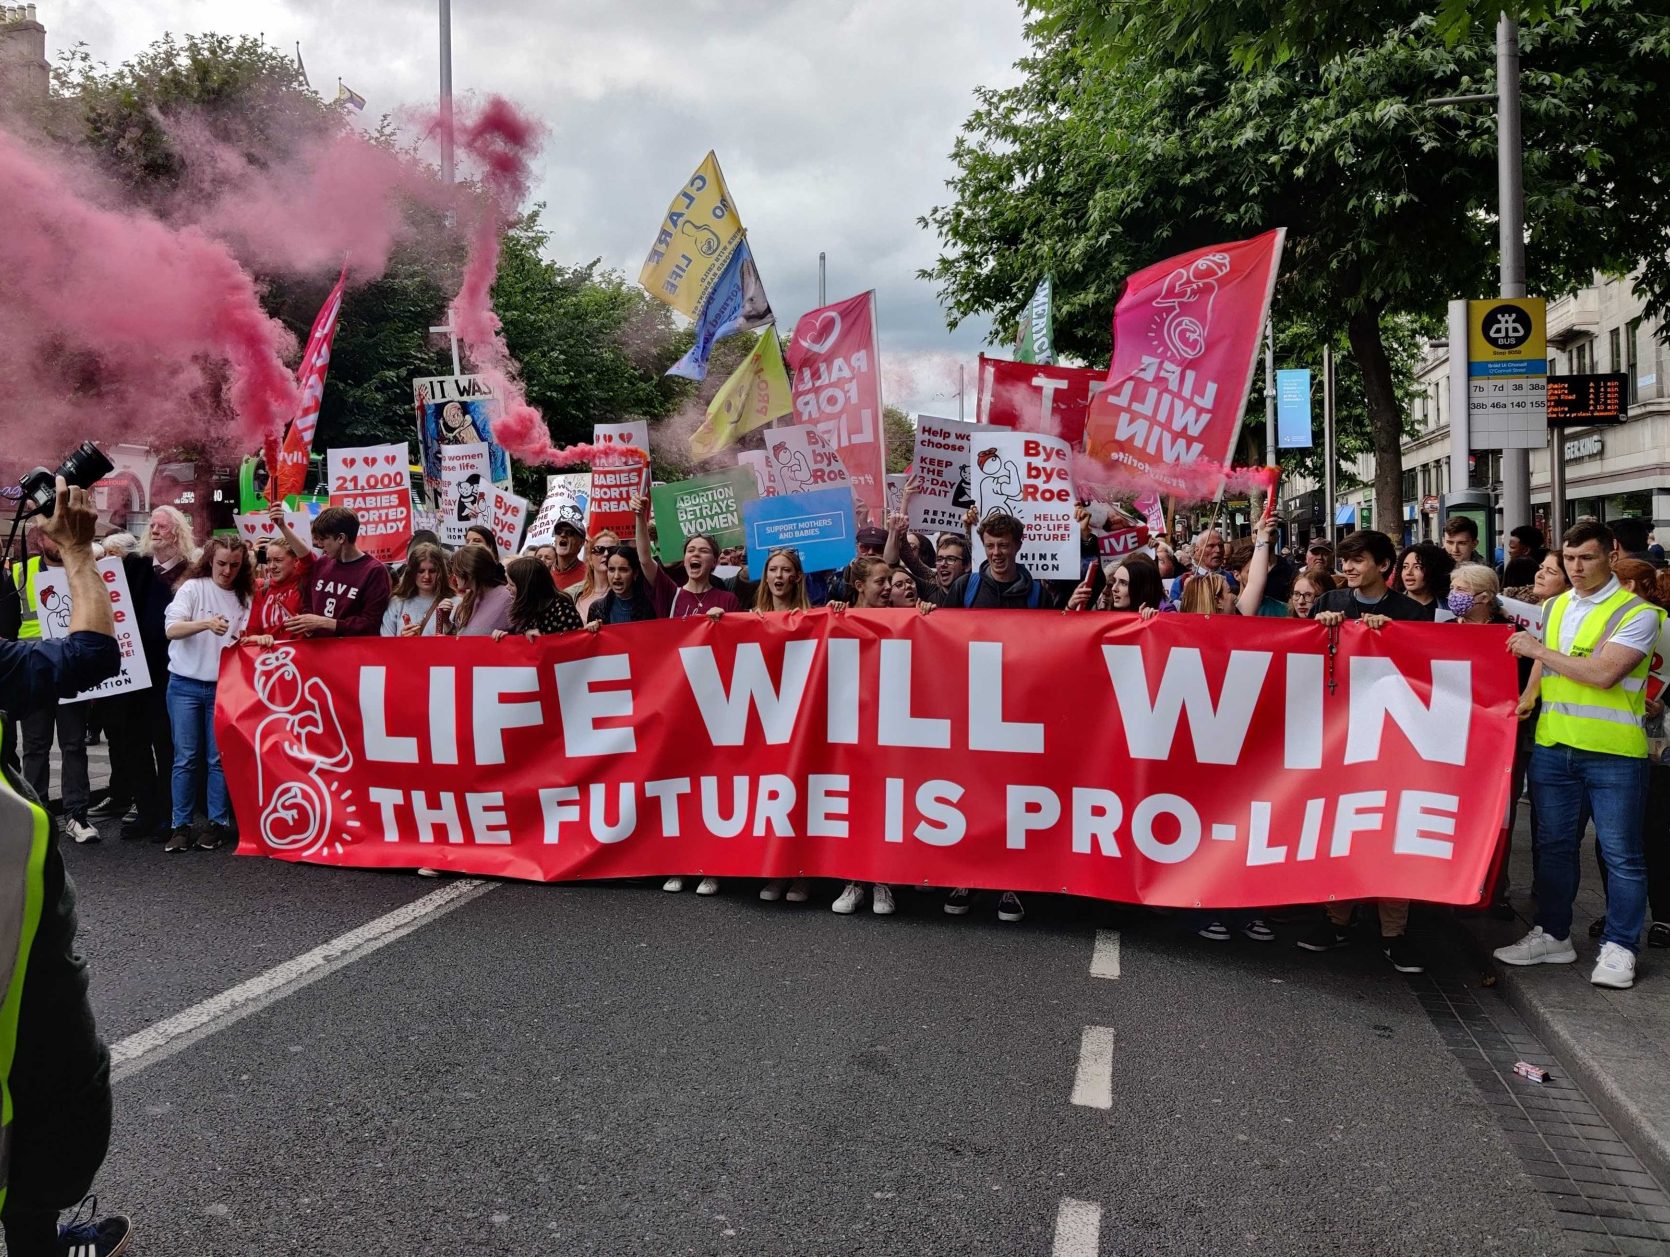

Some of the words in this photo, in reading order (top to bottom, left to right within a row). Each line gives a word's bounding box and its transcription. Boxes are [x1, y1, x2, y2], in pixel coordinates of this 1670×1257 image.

[429, 380, 447, 400] IT
[454, 378, 492, 397] WAS
[1472, 385, 1485, 393] 7b
[1492, 384, 1504, 392] 7d
[1528, 383, 1546, 391] 38a
[1470, 402, 1488, 410] 38b
[1490, 401, 1507, 409] 46a
[1510, 401, 1527, 409] 140
[1530, 400, 1546, 408] 155
[921, 426, 951, 440] Help
[920, 439, 965, 452] choose
[1023, 440, 1067, 462] Bye
[448, 452, 484, 462] women
[811, 448, 839, 467] bye
[920, 456, 953, 468] KEEP
[459, 463, 478, 471] life.
[920, 466, 944, 477] THE
[1026, 462, 1069, 484] bye
[335, 471, 404, 492] 21,000
[593, 472, 639, 485] BABIES
[811, 468, 847, 485] Roe
[917, 476, 957, 489] 3-DAY
[591, 486, 641, 499] ABORTE
[676, 487, 735, 508] ABORTION
[917, 486, 950, 498] WAIT
[1022, 484, 1071, 502] Roe
[343, 494, 399, 508] BABIES
[494, 494, 520, 517] Bye
[590, 500, 632, 512] ALREA
[358, 507, 407, 521] ORTED
[677, 499, 737, 521] BETRAYS
[923, 509, 962, 520] RETHI
[1033, 513, 1070, 521] HELLO
[358, 520, 406, 536] READY
[493, 512, 516, 534] bye
[679, 512, 739, 537] WOMEN
[765, 523, 798, 534] SUPPORT
[798, 518, 833, 529] MOTHERS
[921, 517, 963, 528] ABORTI
[531, 527, 551, 539] WAIT
[778, 531, 794, 540] AND
[794, 528, 820, 537] BABIES
[1020, 553, 1058, 561] HINK
[1028, 563, 1060, 571] TION
[315, 579, 359, 599] SAVE
[359, 653, 637, 765] LIFE
[679, 638, 1044, 754] WILL
[1101, 644, 1472, 769] WIN
[369, 786, 511, 845] THE
[538, 773, 850, 844] FUTURE
[884, 778, 967, 847] IS
[1005, 784, 1459, 867] PRO-LIFE
